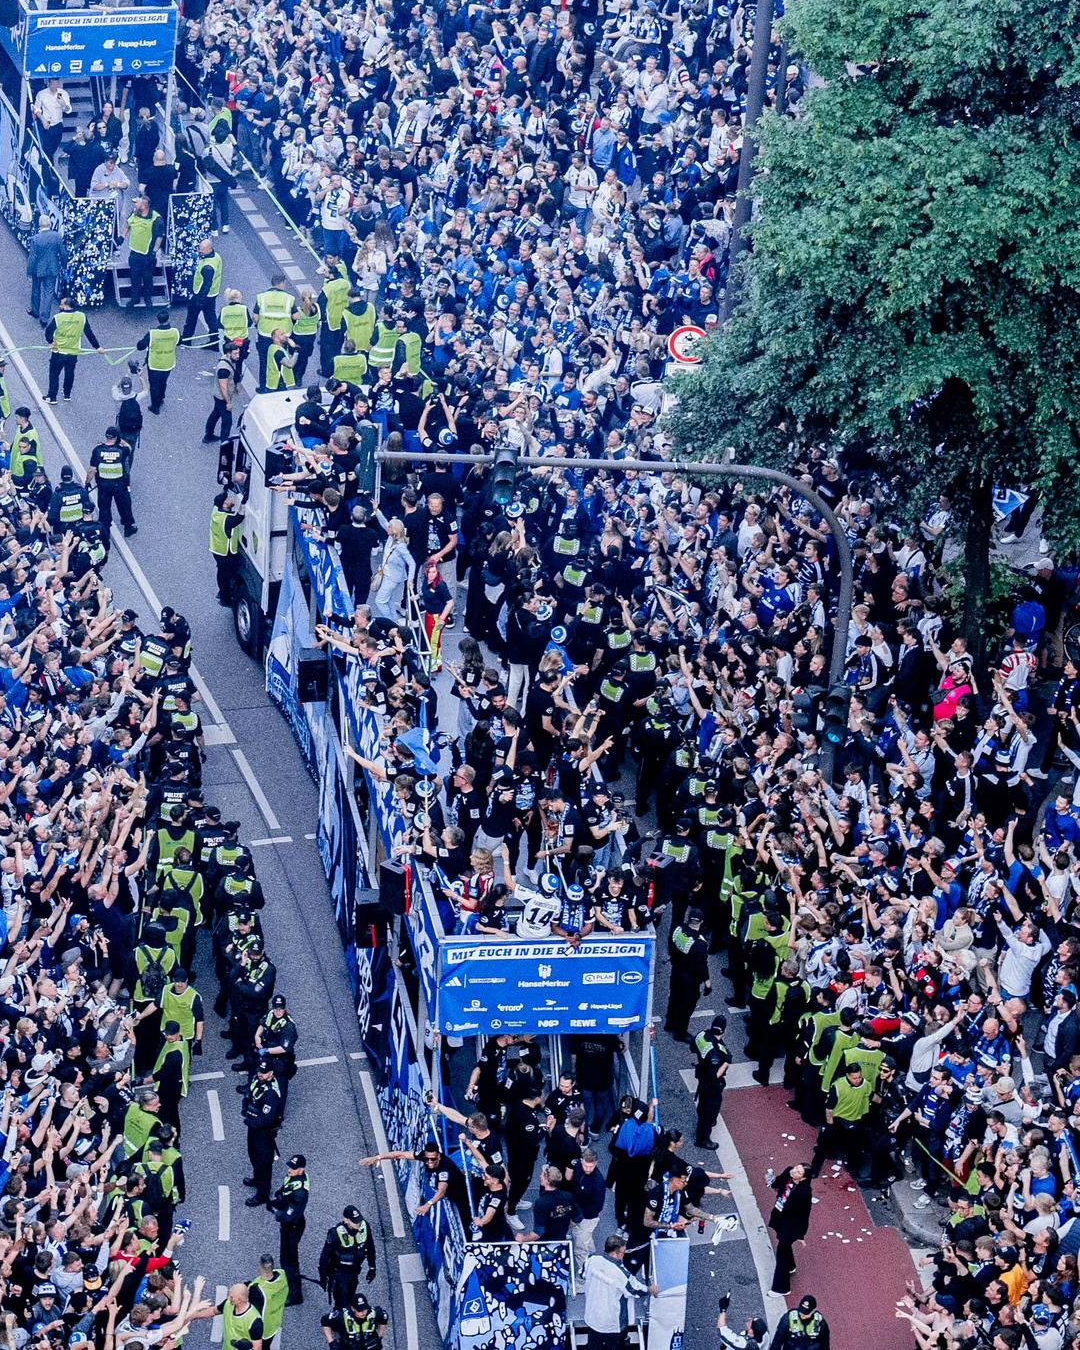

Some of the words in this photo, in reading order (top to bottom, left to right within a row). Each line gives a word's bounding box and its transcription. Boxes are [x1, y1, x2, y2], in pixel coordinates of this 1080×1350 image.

[110, 15, 166, 24] BUNDESLIGA!
[118, 39, 157, 49] Hapag-Lloyd
[526, 907, 555, 927] 14
[451, 951, 475, 961] MIT
[478, 949, 512, 957] EUCH
[534, 948, 553, 956] DIE
[556, 946, 641, 956] BNDESLIGA!
[518, 980, 570, 988] HanseMerkur
[570, 1019, 596, 1027] REWE
